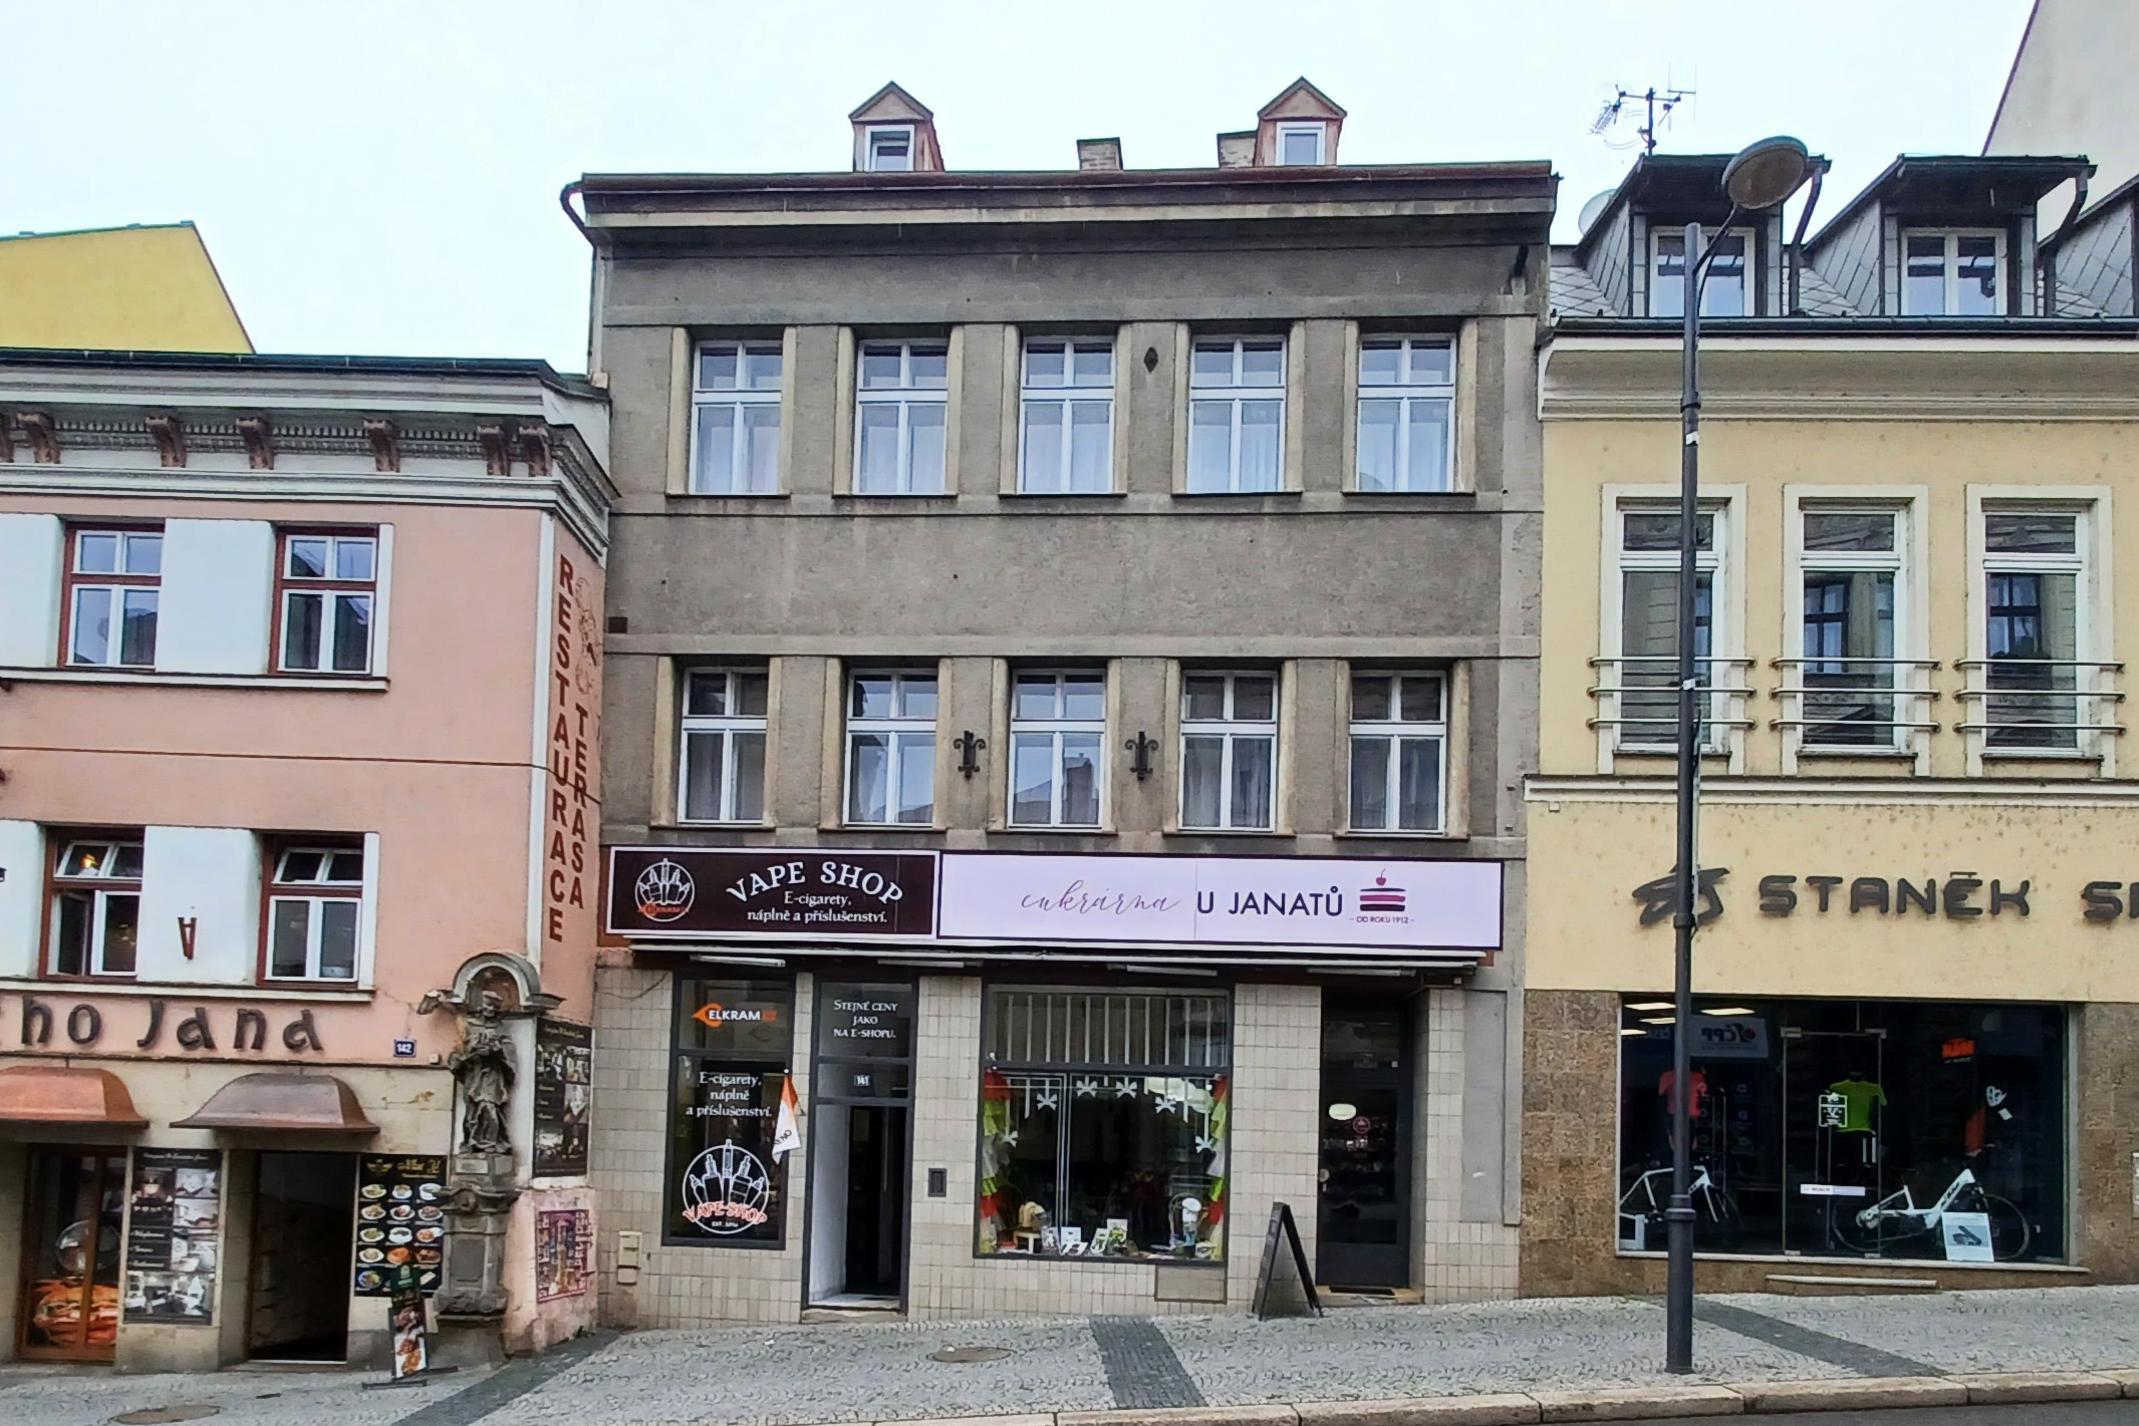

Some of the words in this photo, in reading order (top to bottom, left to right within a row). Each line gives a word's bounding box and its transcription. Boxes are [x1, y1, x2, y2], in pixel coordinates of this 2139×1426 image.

[547, 554, 574, 943] RESTAURACE
[568, 702, 589, 910] TERASA
[726, 862, 806, 903] VAPE
[820, 861, 903, 904] SHOP
[1021, 879, 1181, 915] cukrárna
[1197, 890, 1214, 914] U
[1229, 885, 1343, 916] JANATŮ
[747, 909, 790, 923] náplně
[793, 912, 801, 921] a
[804, 909, 888, 924] příslušenství.
[1356, 915, 1368, 923] OD
[1370, 915, 1390, 923] ROKU
[871, 1002, 898, 1011] CENY
[0, 993, 102, 1046] ho
[136, 999, 324, 1053] Jana
[708, 1010, 761, 1021] ELKRAM
[853, 1015, 878, 1026] JAKO
[833, 1028, 848, 1037] NA
[710, 1089, 750, 1104] náplně
[685, 1107, 693, 1116] a
[696, 1104, 772, 1119] příslušenství.
